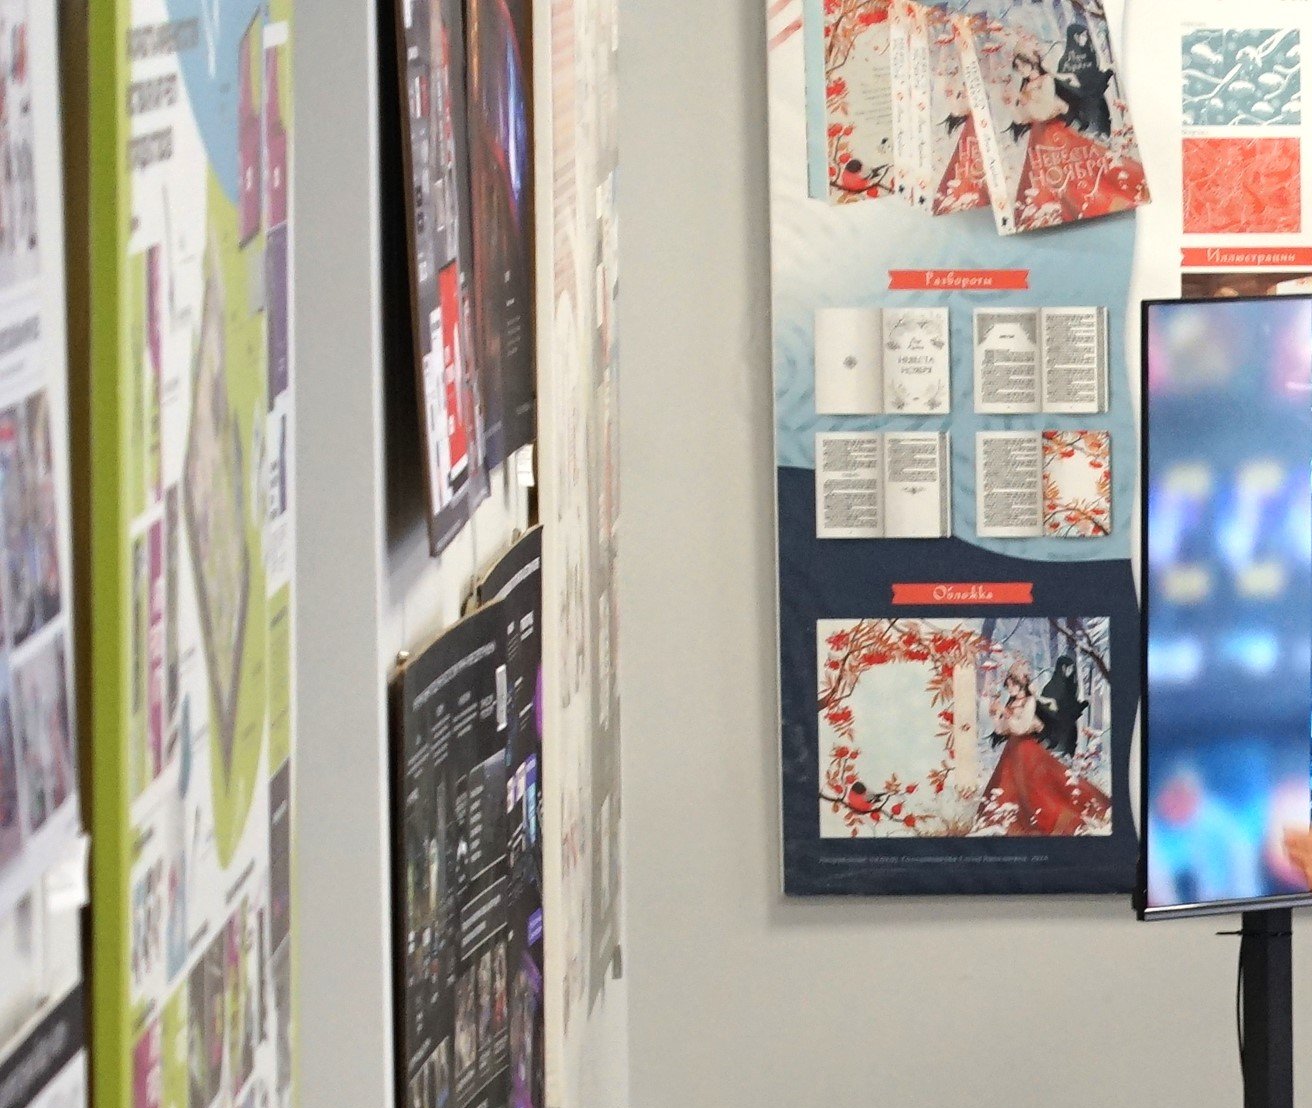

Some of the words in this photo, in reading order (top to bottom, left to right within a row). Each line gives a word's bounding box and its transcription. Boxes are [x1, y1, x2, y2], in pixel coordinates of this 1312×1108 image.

[1029, 144, 1100, 169] НЕВЕСТА
[1028, 159, 1113, 186] НОЯБРЯ
[925, 270, 993, 287] Развороты
[932, 584, 994, 600] Обложка
